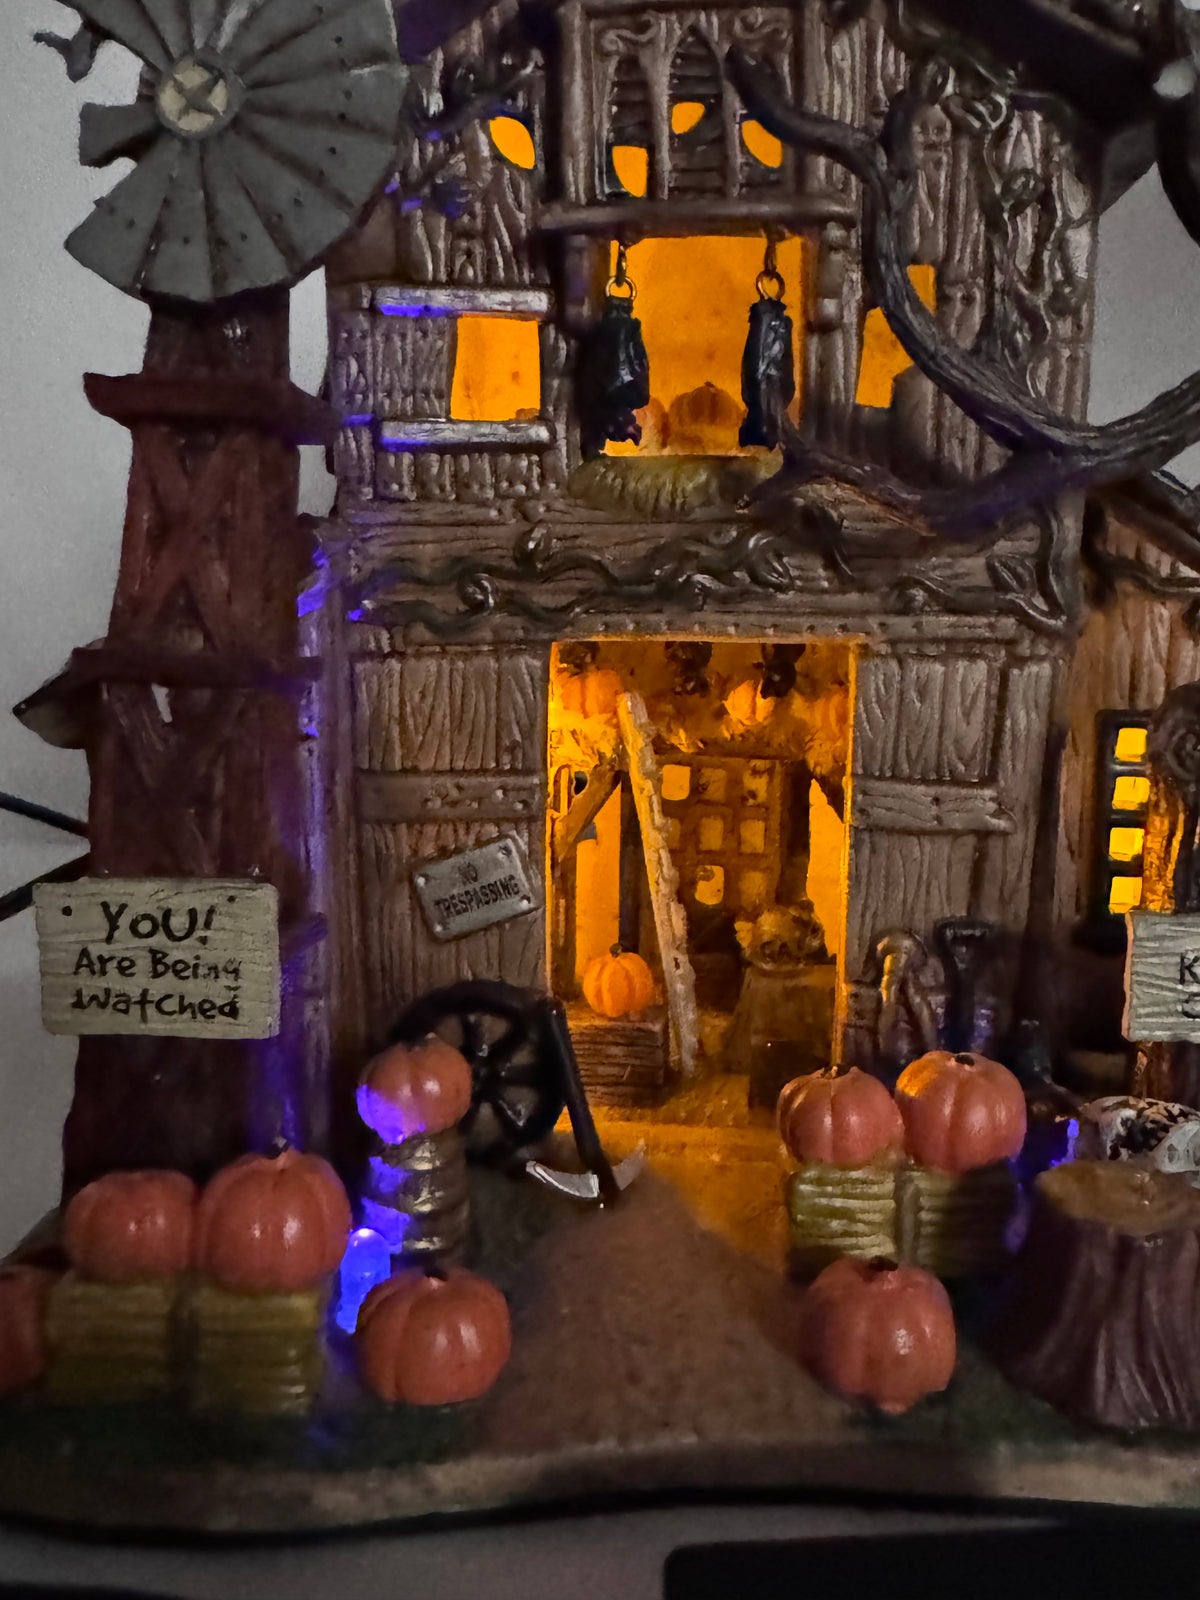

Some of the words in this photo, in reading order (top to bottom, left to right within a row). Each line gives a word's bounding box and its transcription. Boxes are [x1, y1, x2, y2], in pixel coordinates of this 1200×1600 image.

[459, 862, 478, 886] NO
[434, 874, 520, 919] TRESPASSING
[73, 947, 136, 977] Are
[149, 947, 241, 987] Being
